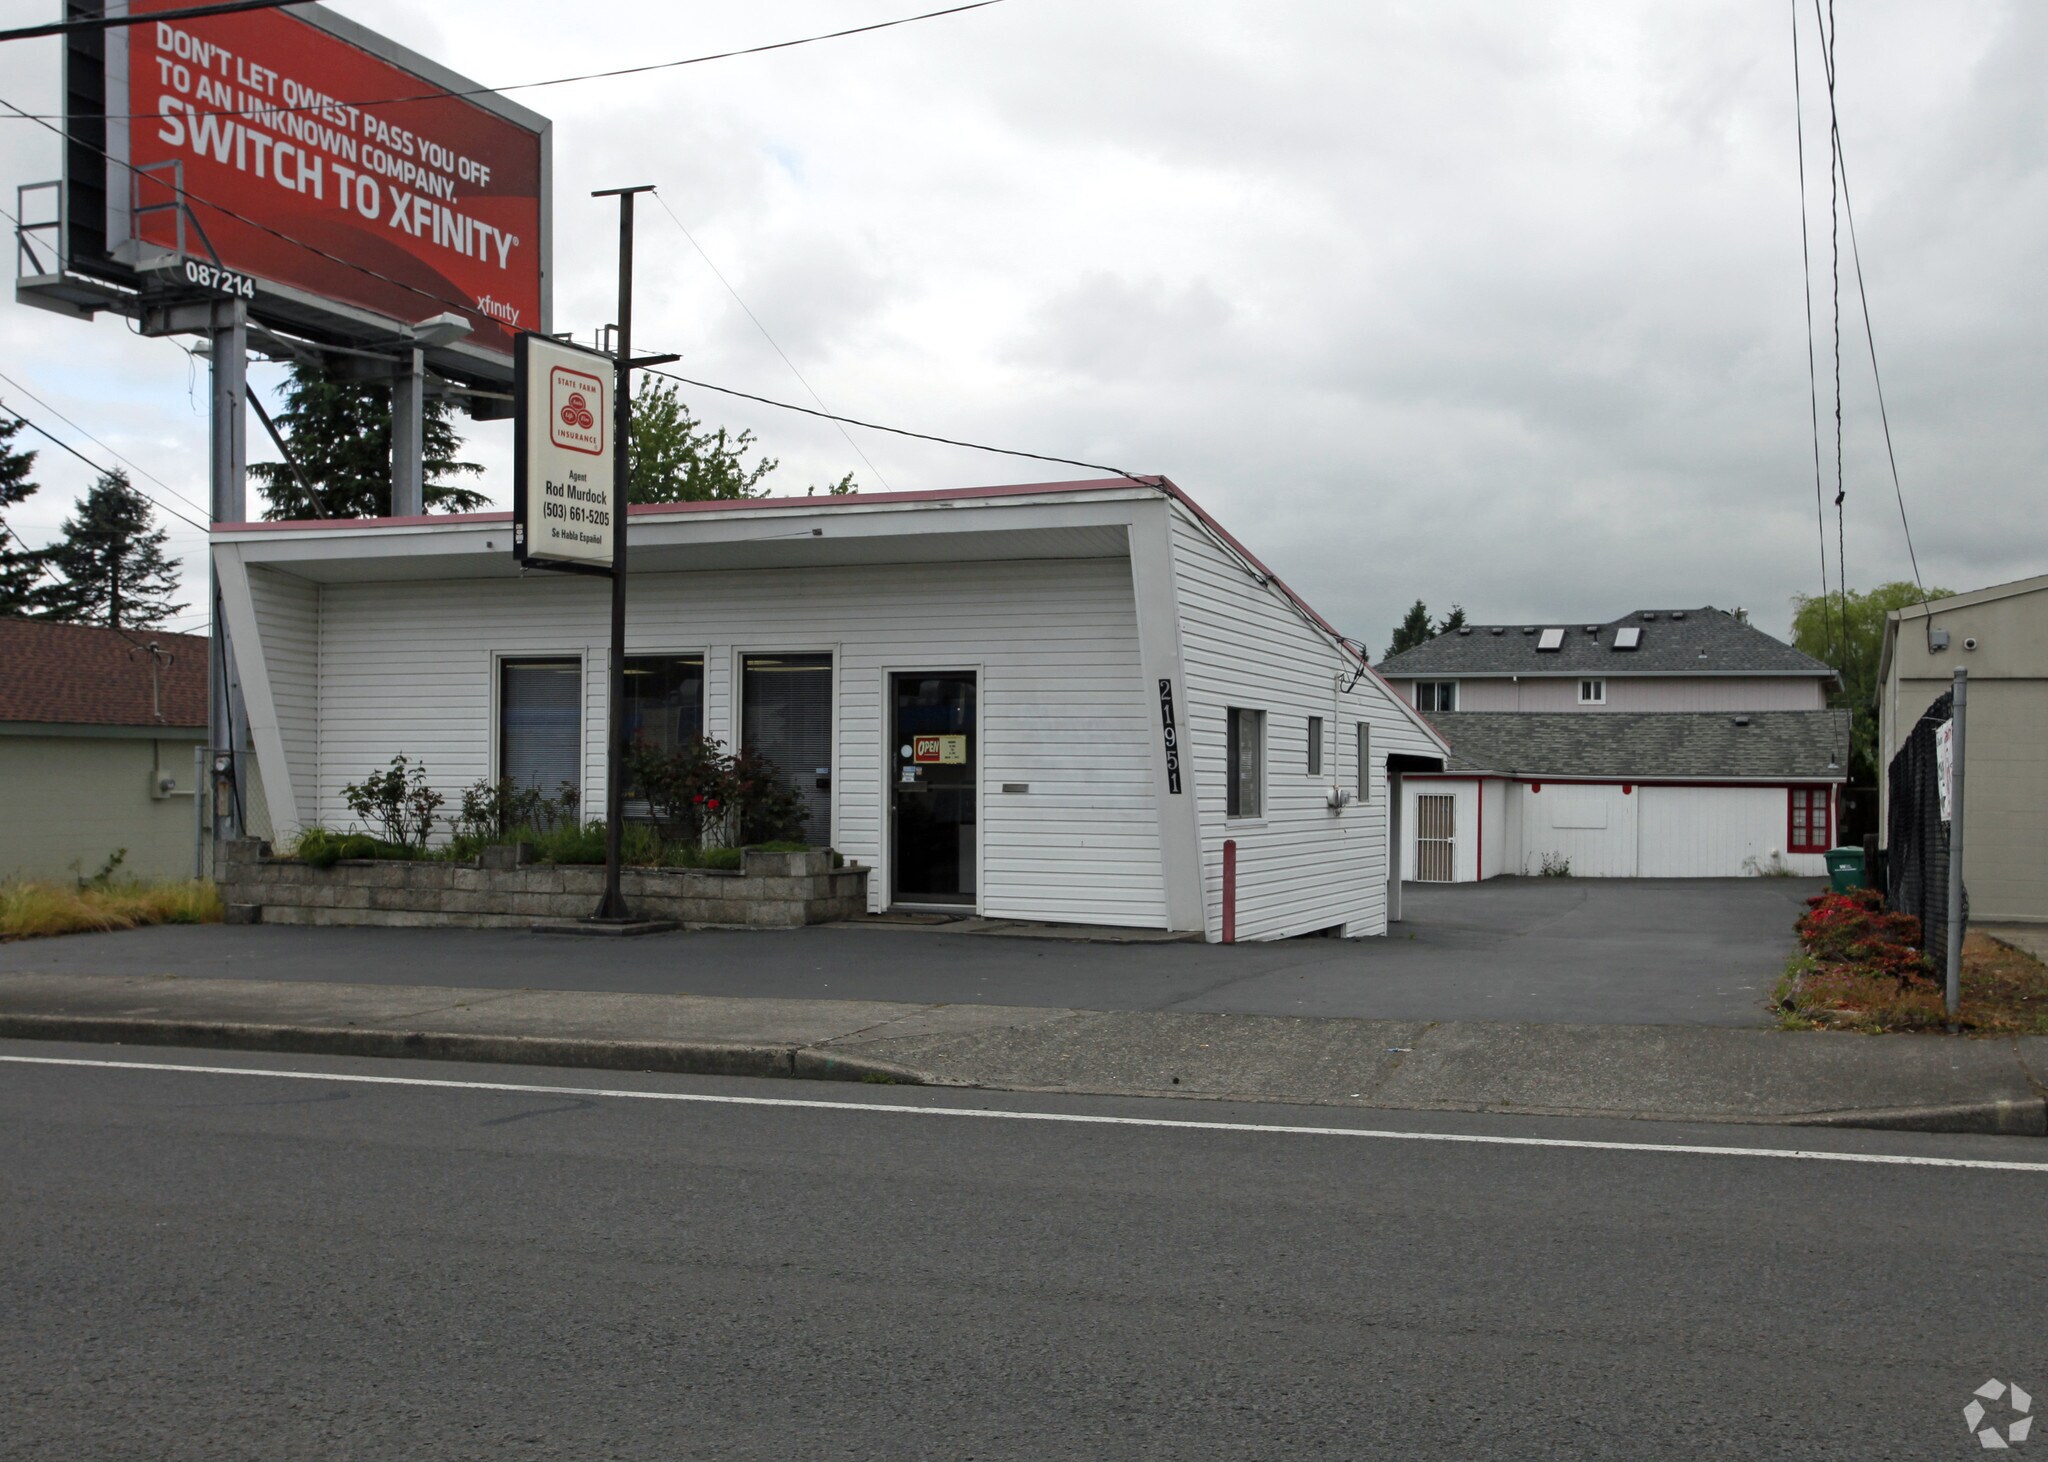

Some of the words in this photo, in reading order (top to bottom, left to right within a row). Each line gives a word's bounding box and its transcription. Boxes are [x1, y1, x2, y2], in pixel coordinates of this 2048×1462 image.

[157, 21, 232, 76] DON'T
[237, 56, 278, 96] LET
[283, 78, 360, 132] QWEST
[364, 113, 414, 156] PASS
[417, 137, 454, 173] YOU
[458, 156, 490, 187] OFF
[156, 56, 190, 93] TO
[196, 75, 232, 112] AN
[238, 91, 357, 163] UNKNOWN
[362, 144, 457, 204] COMPANY.
[158, 95, 323, 200] SWITCH
[332, 162, 380, 220] TO
[186, 261, 255, 299] 087214
[477, 295, 520, 326] xfinity
[558, 378, 576, 389] STATE
[579, 383, 597, 393] FARM
[558, 429, 597, 444] INSURANCE
[569, 469, 587, 482] Agent
[546, 480, 564, 498] Rod
[567, 484, 607, 505] Murdock
[543, 501, 567, 522] (503)
[570, 506, 610, 527] 661-5205
[552, 527, 560, 538] Se
[561, 529, 578, 541] Habla
[580, 532, 602, 544] Español
[917, 740, 940, 756] OPEN
[1159, 680, 1180, 792] 21951
